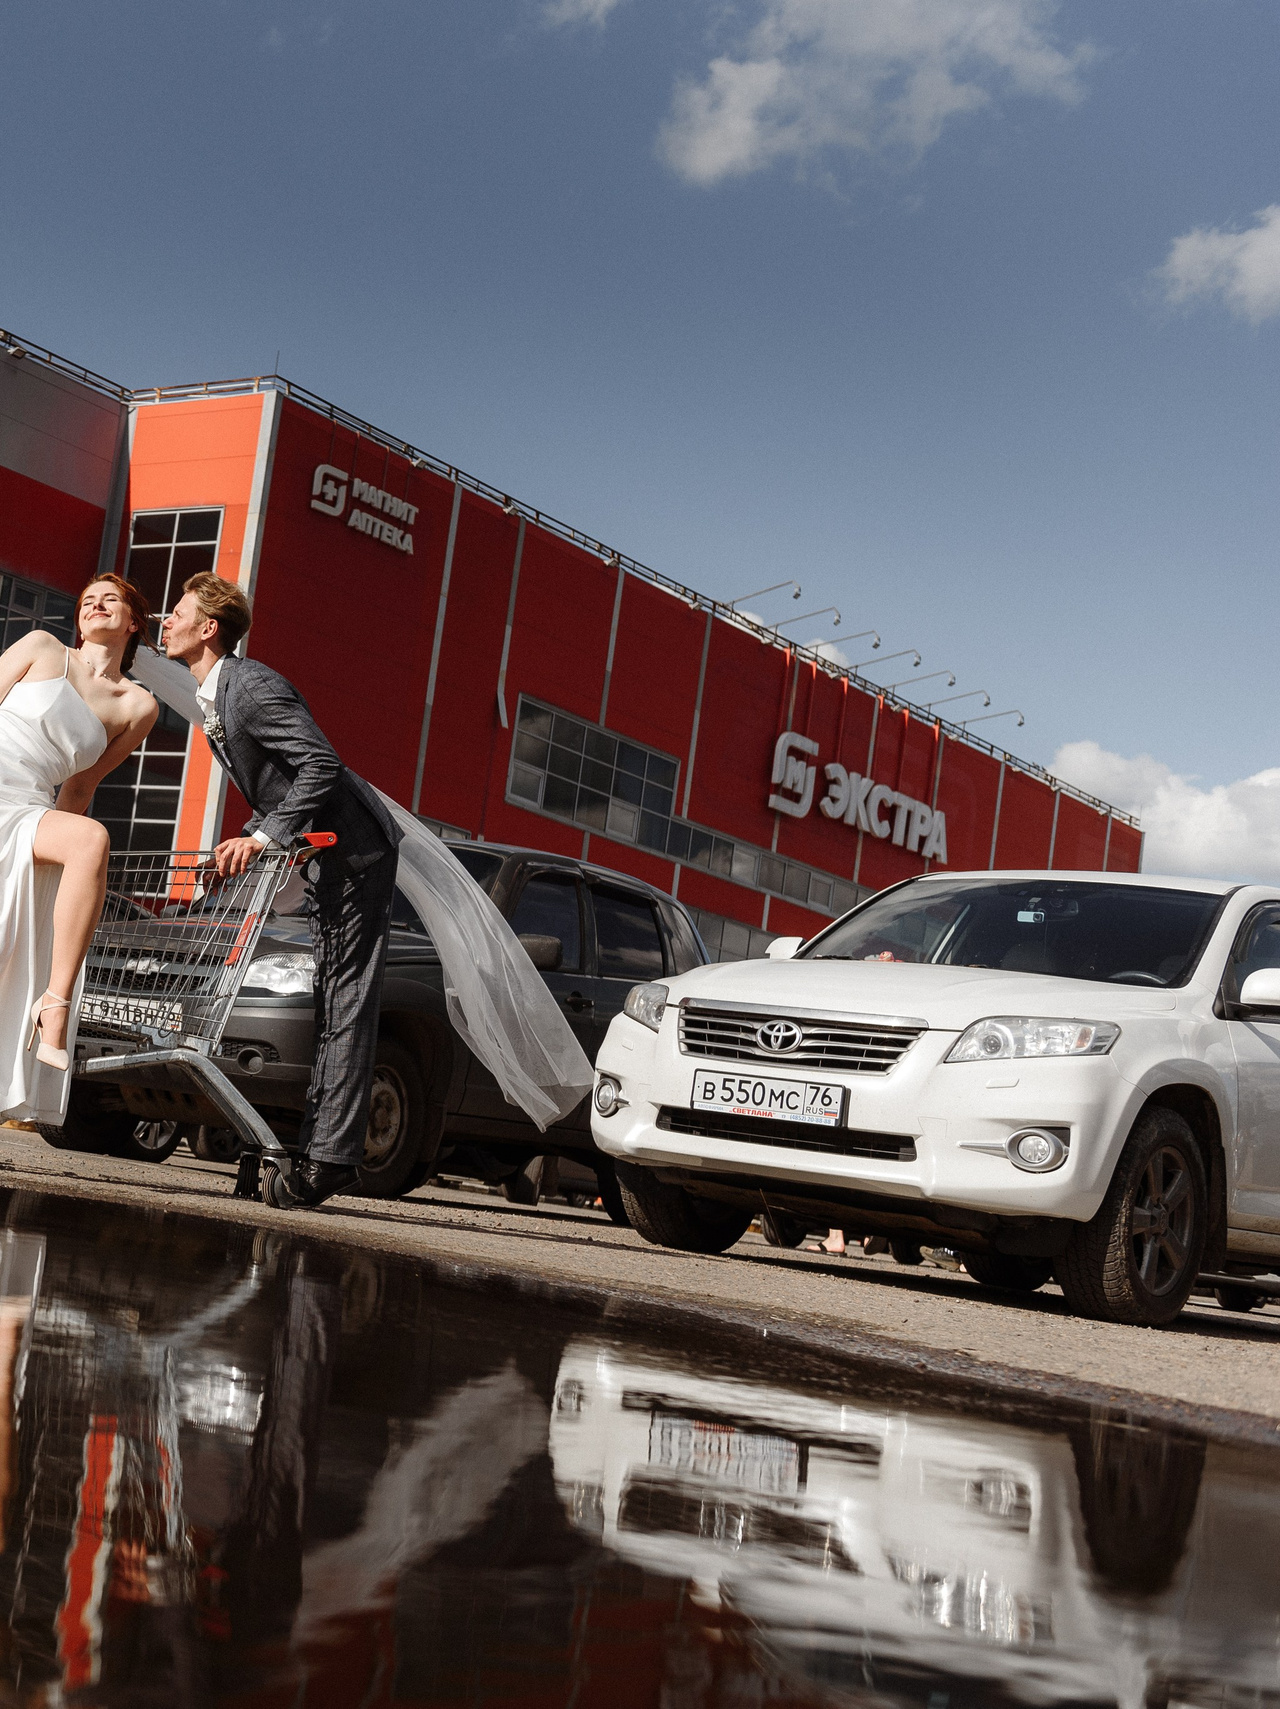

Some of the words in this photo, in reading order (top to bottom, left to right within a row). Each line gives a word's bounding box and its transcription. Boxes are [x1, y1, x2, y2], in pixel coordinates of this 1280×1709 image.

[351, 477, 420, 526] МАГНИТ
[347, 508, 414, 556] АПТЕКА
[819, 762, 948, 866] ЭКСТРА
[805, 1106, 824, 1116] RUS
[809, 1085, 833, 1107] 76
